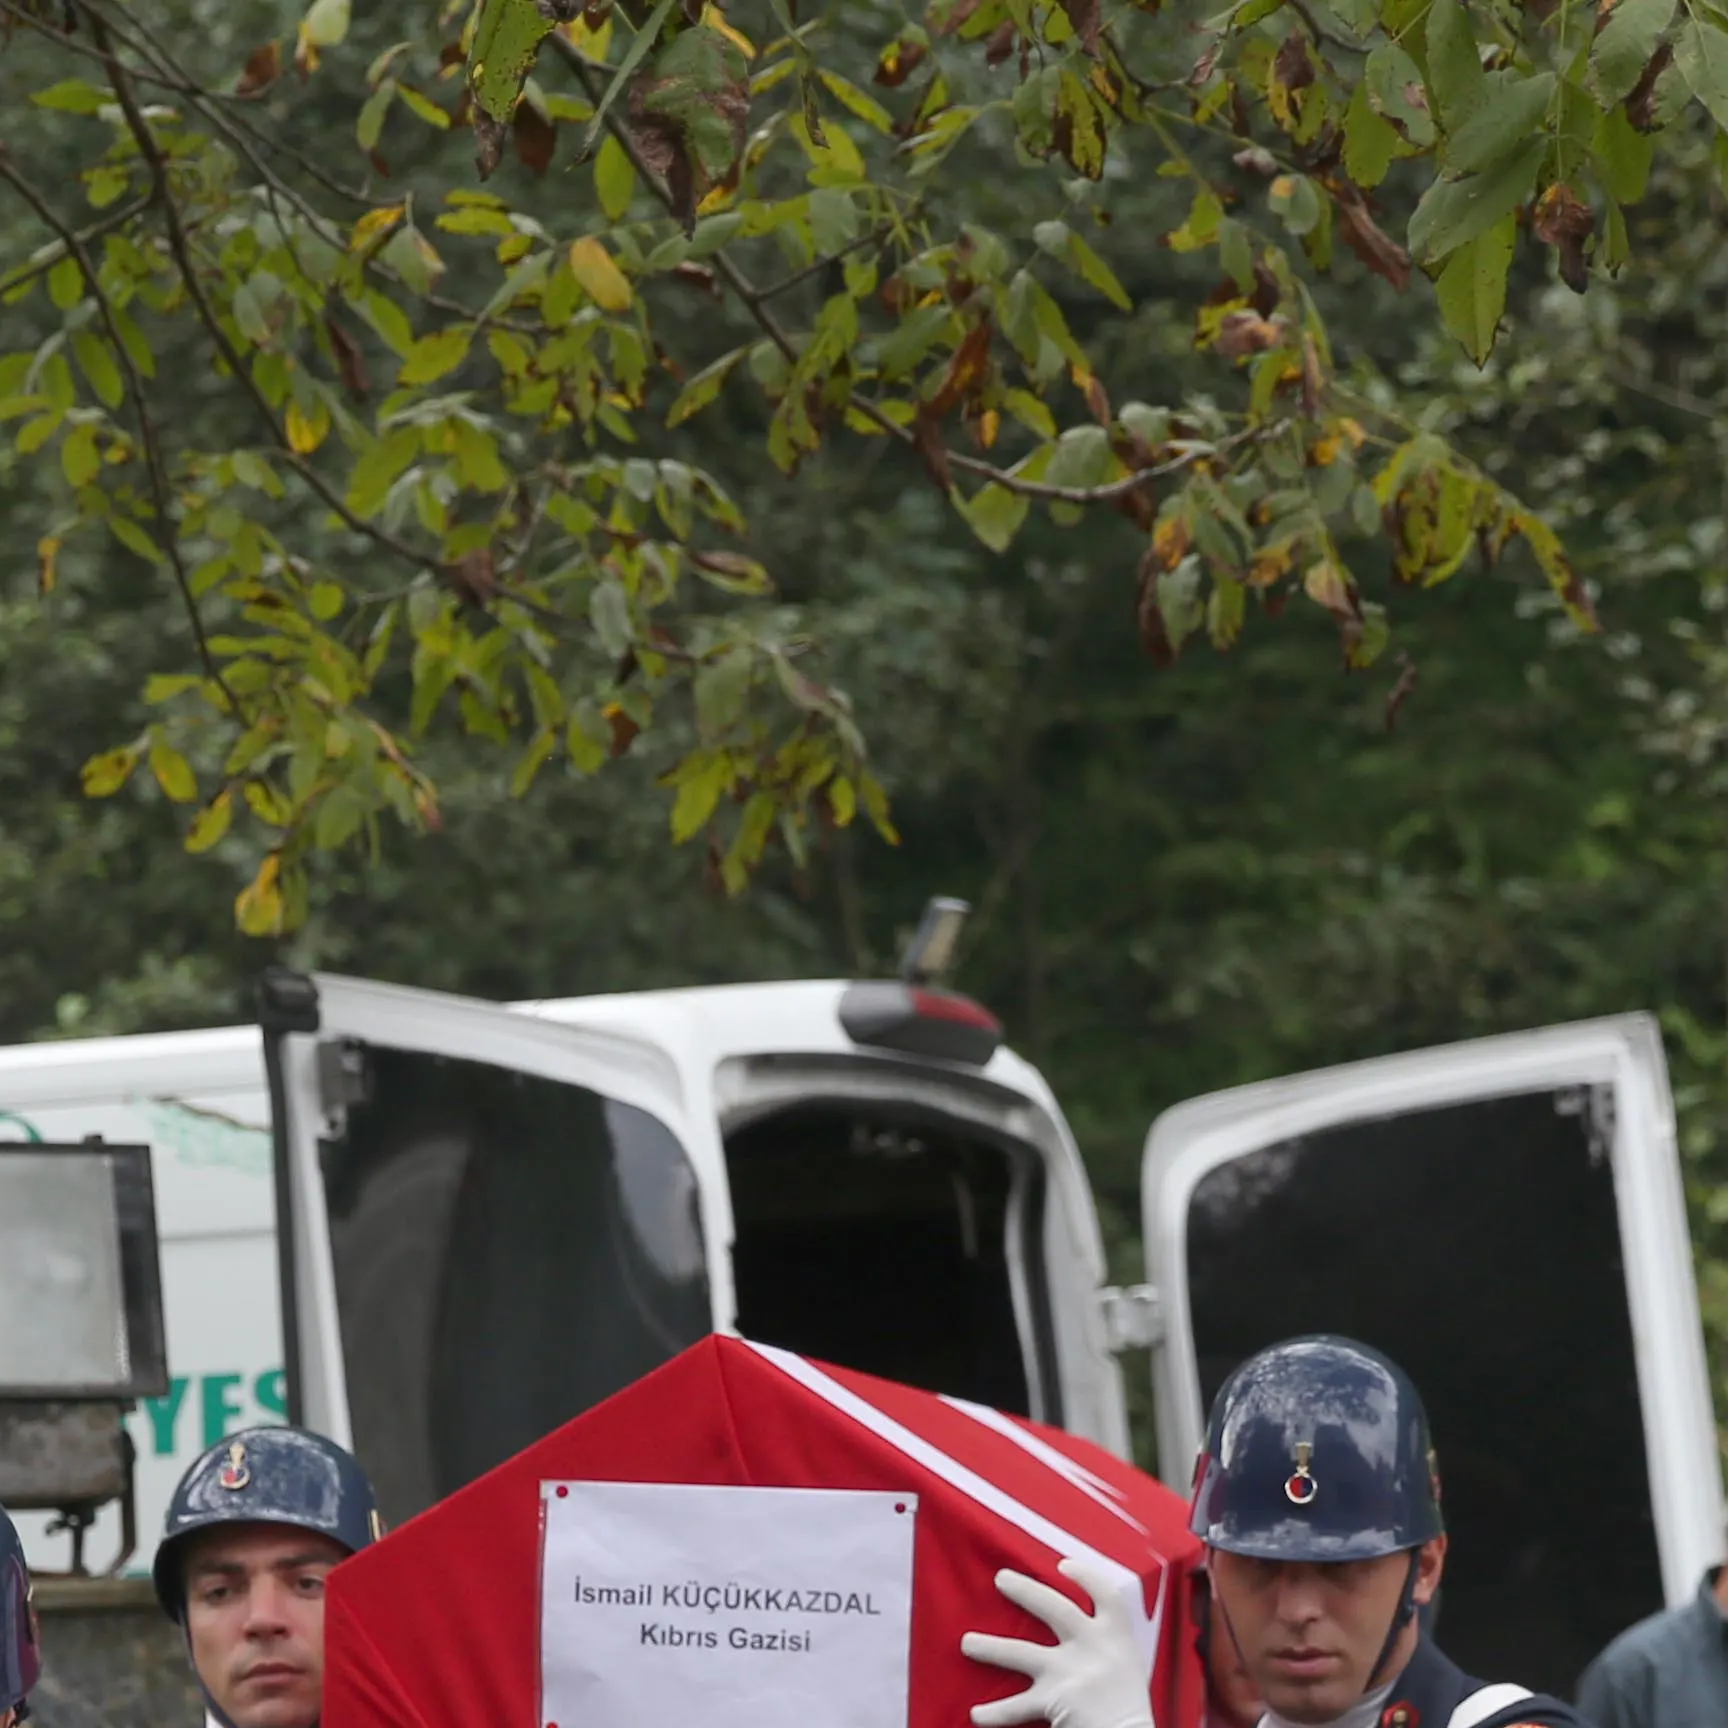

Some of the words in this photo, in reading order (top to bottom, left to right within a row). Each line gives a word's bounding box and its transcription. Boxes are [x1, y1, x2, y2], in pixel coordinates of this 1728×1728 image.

[575, 1574, 652, 1606] İsmail
[663, 1580, 881, 1616] KÜÇÜKKAZDAL
[640, 1623, 719, 1649] Kıbrıs
[728, 1627, 811, 1652] Gazisi
